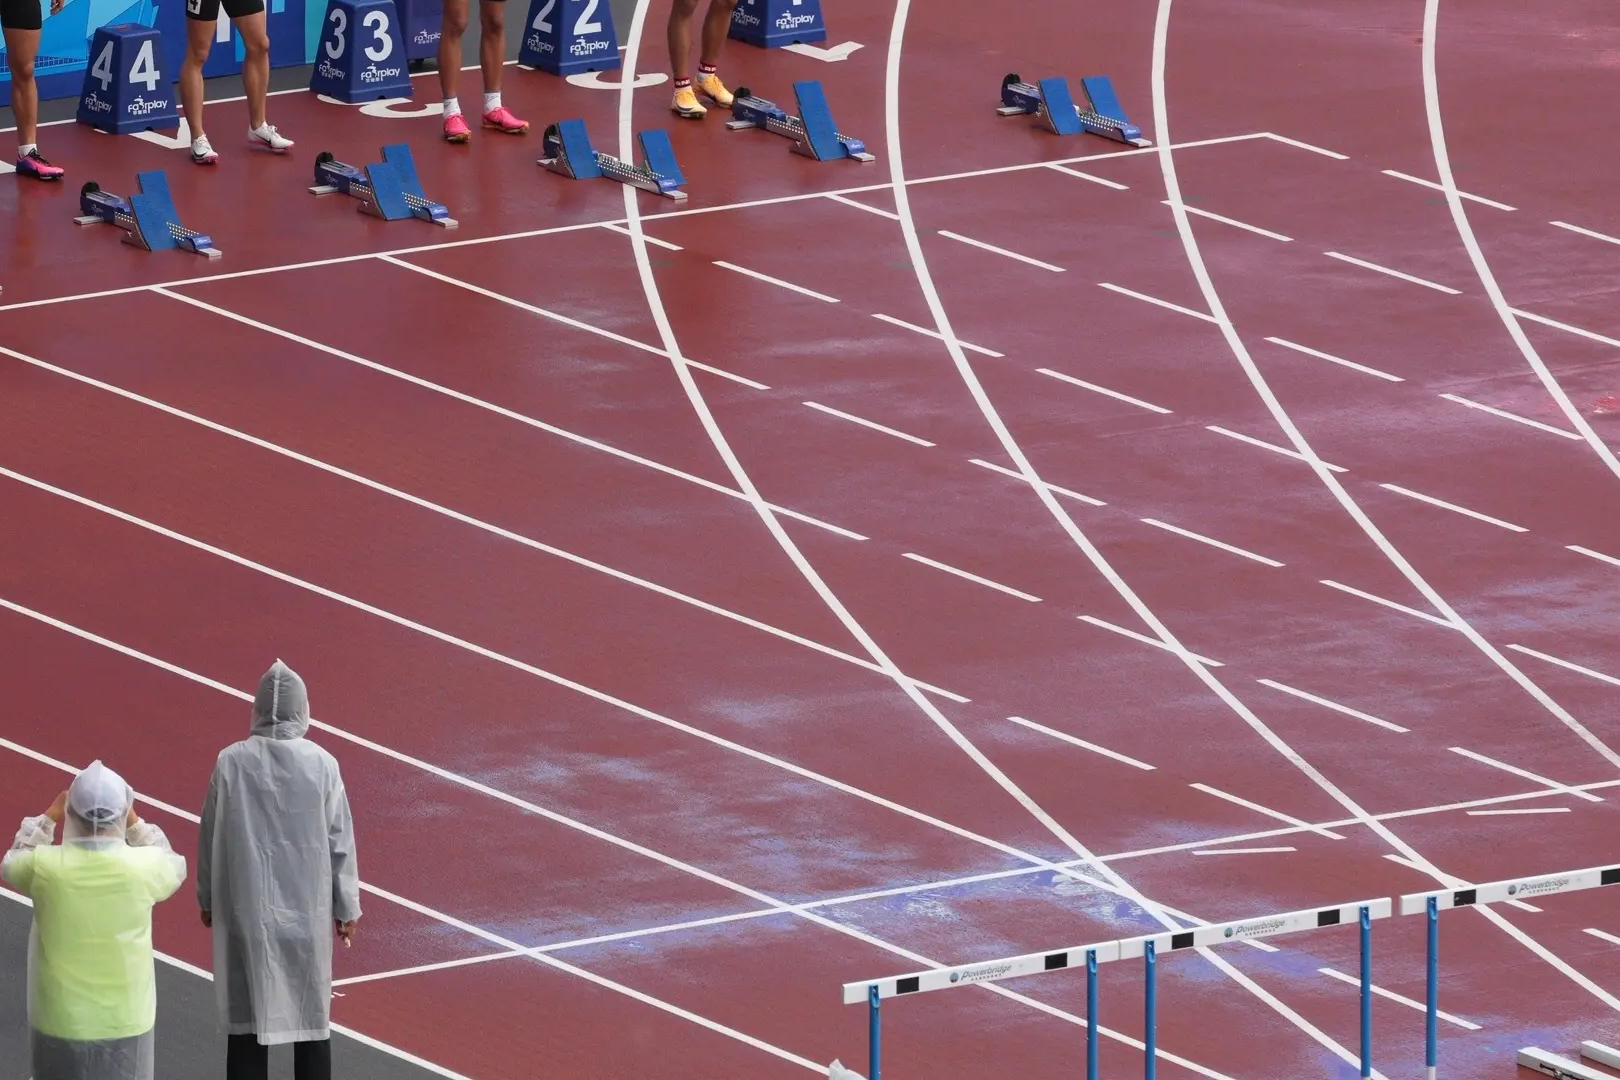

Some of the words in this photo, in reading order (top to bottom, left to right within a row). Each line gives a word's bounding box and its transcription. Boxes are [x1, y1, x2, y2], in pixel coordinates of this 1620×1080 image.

[325, 8, 347, 59] 3
[362, 10, 393, 62] 3
[91, 40, 114, 91] 4
[129, 40, 160, 91] 4
